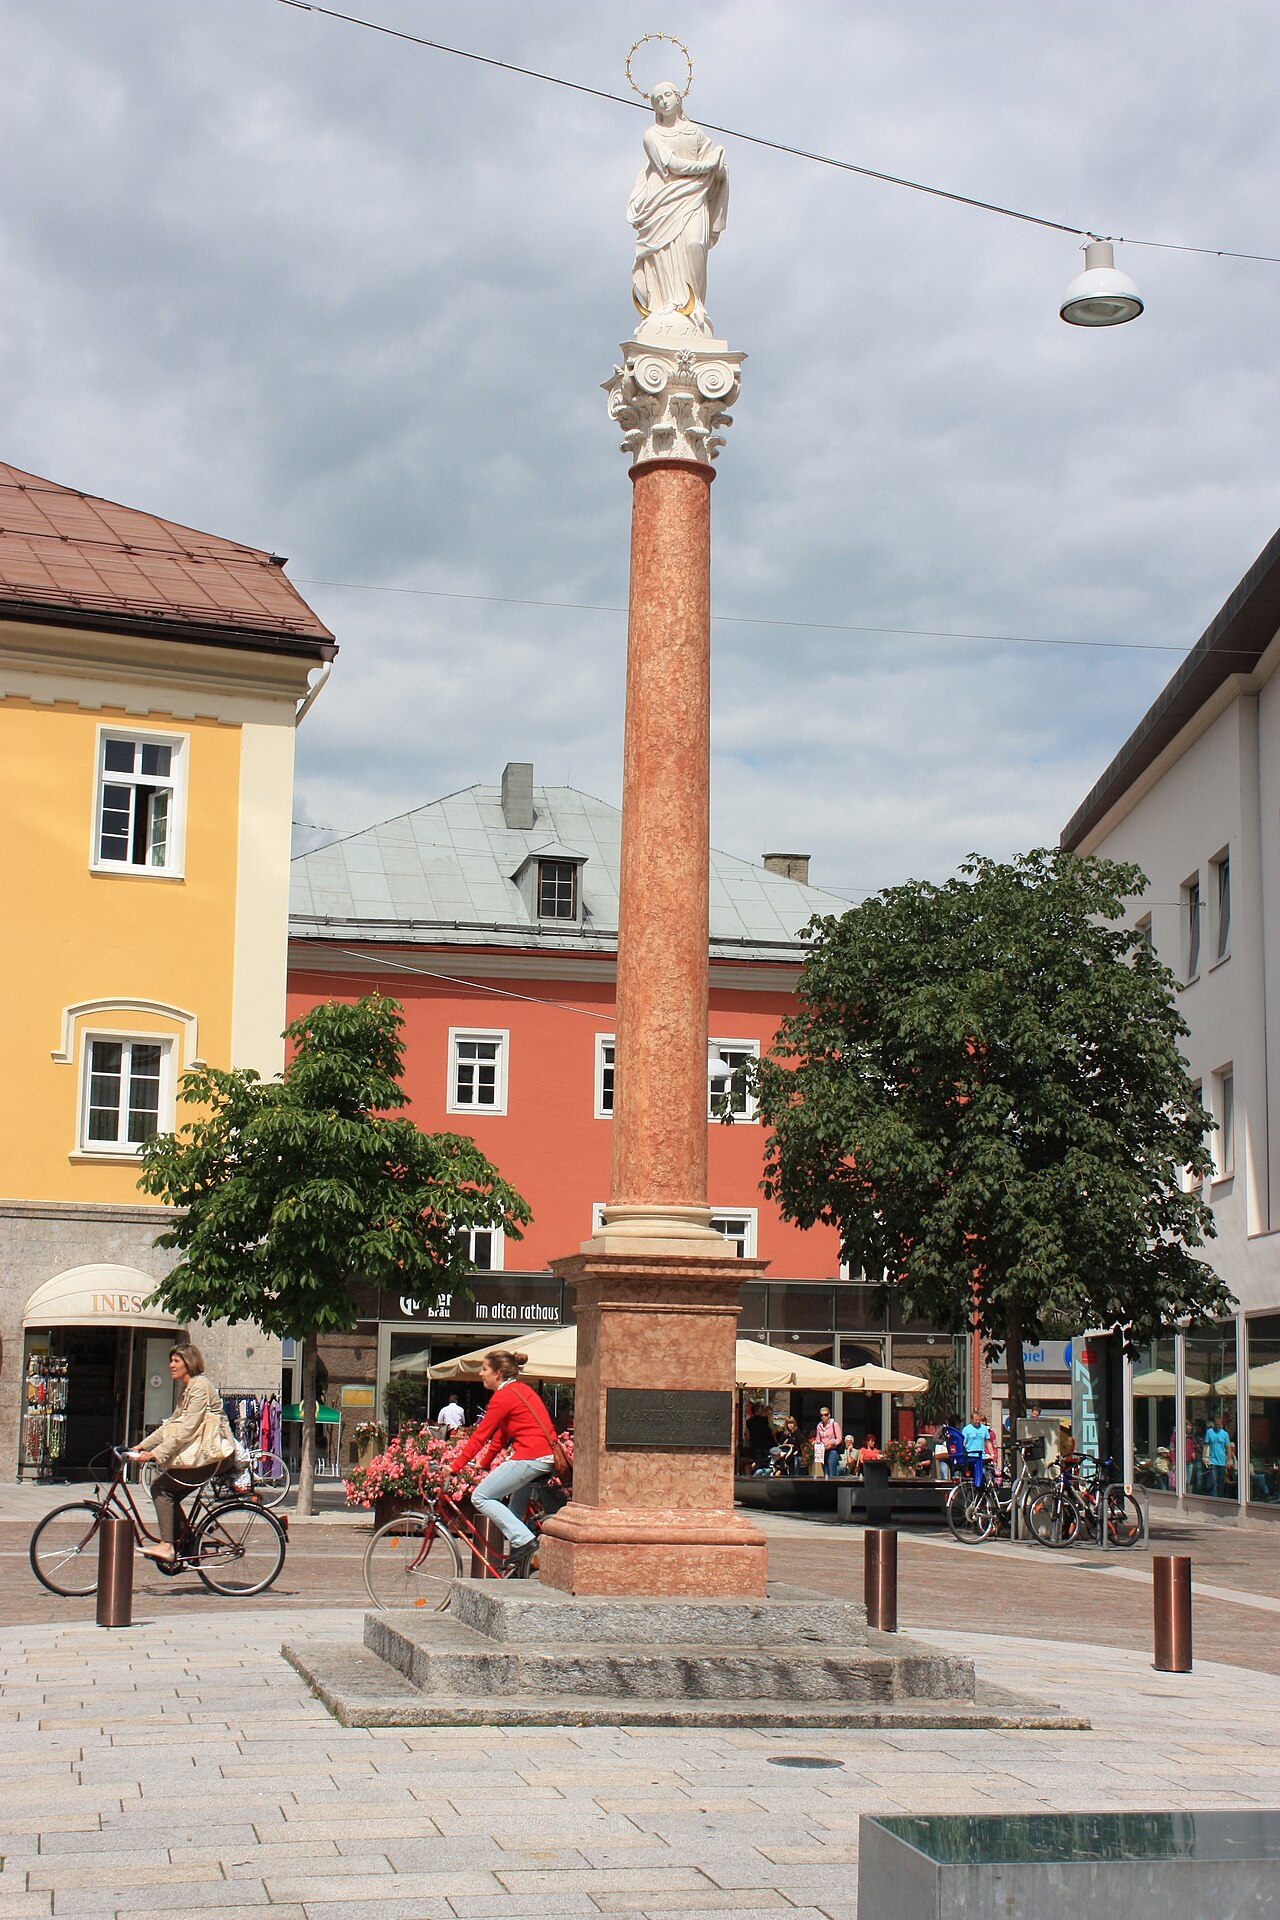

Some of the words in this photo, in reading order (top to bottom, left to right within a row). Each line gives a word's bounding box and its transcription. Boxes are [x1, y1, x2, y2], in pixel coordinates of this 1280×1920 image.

[91, 1294, 142, 1313] INES
[427, 1307, 451, 1318] bräu
[475, 1302, 488, 1318] im
[491, 1302, 517, 1320] alten
[520, 1304, 559, 1320] rathaus
